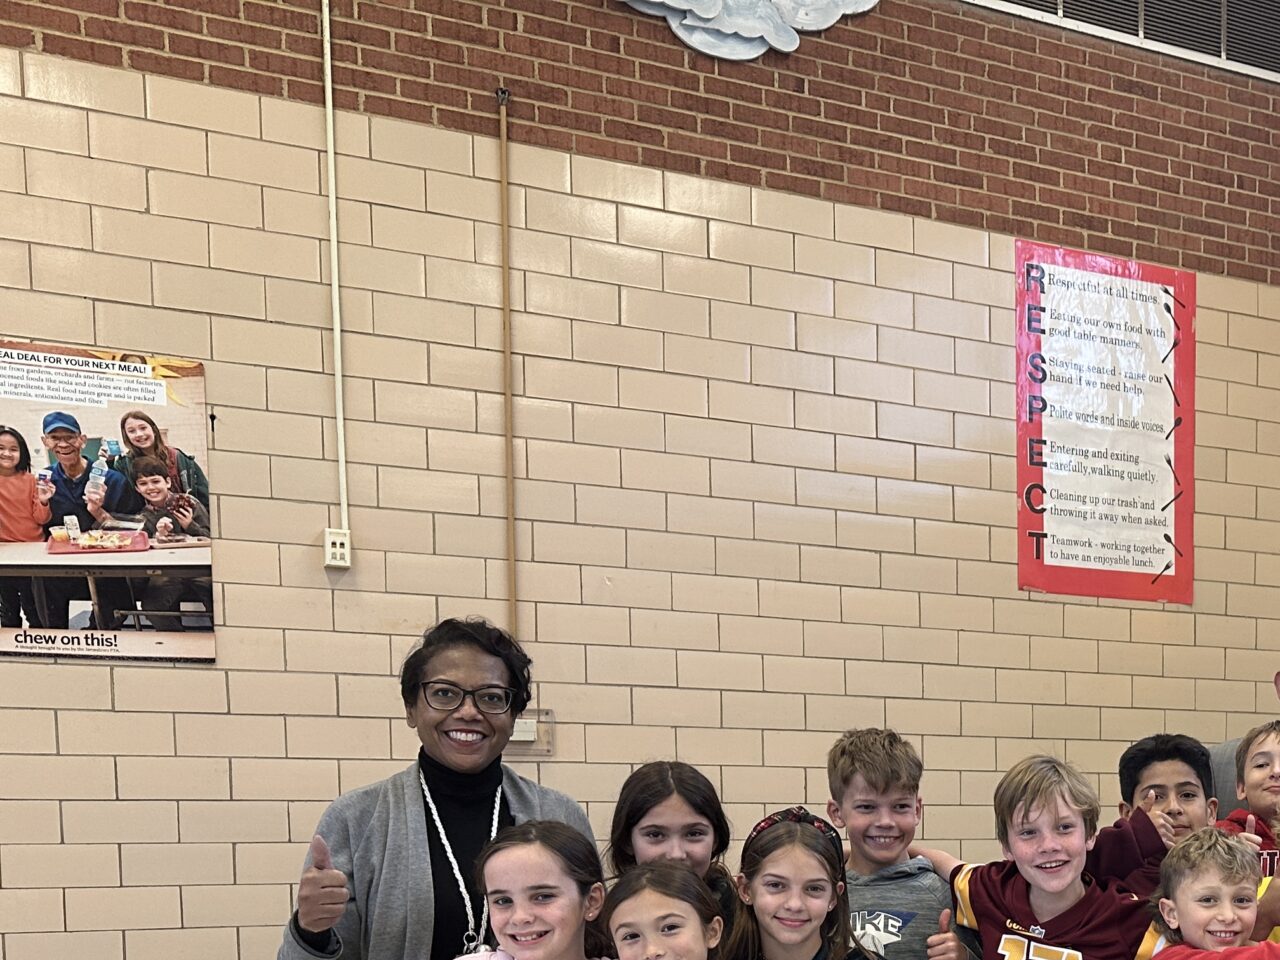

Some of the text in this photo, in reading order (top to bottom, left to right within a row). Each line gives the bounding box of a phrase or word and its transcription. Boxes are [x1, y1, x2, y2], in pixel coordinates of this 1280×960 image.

[1048, 273, 1160, 305] Respectful at all times.
[1050, 308, 1166, 339] Eating our own food with
[1048, 327, 1143, 350] good table manners.
[17, 352, 41, 363] DEAL
[43, 356, 62, 365] FOR
[64, 358, 90, 368] YOUR
[92, 360, 116, 371] NEXT
[118, 364, 147, 374] MEAL!
[1048, 356, 1085, 373] Staying
[1087, 364, 1116, 377] seated
[1124, 370, 1146, 381] raise
[1148, 374, 1163, 384] our
[1049, 371, 1145, 396] hand if we need help.
[1049, 404, 1166, 433] Polite words and inside voices.
[1050, 440, 1140, 465] Entering and exiting
[1127, 470, 1158, 484] quietly.
[1049, 488, 1155, 510] Cleaning up our trash and
[1050, 504, 1169, 527] throwing it away when asked.
[1050, 534, 1093, 549] Teamwork
[1100, 541, 1132, 554] working
[1133, 543, 1165, 555] together
[1050, 550, 1155, 568] to have an enjoyable lunch.
[14, 630, 118, 647] chew on this!
